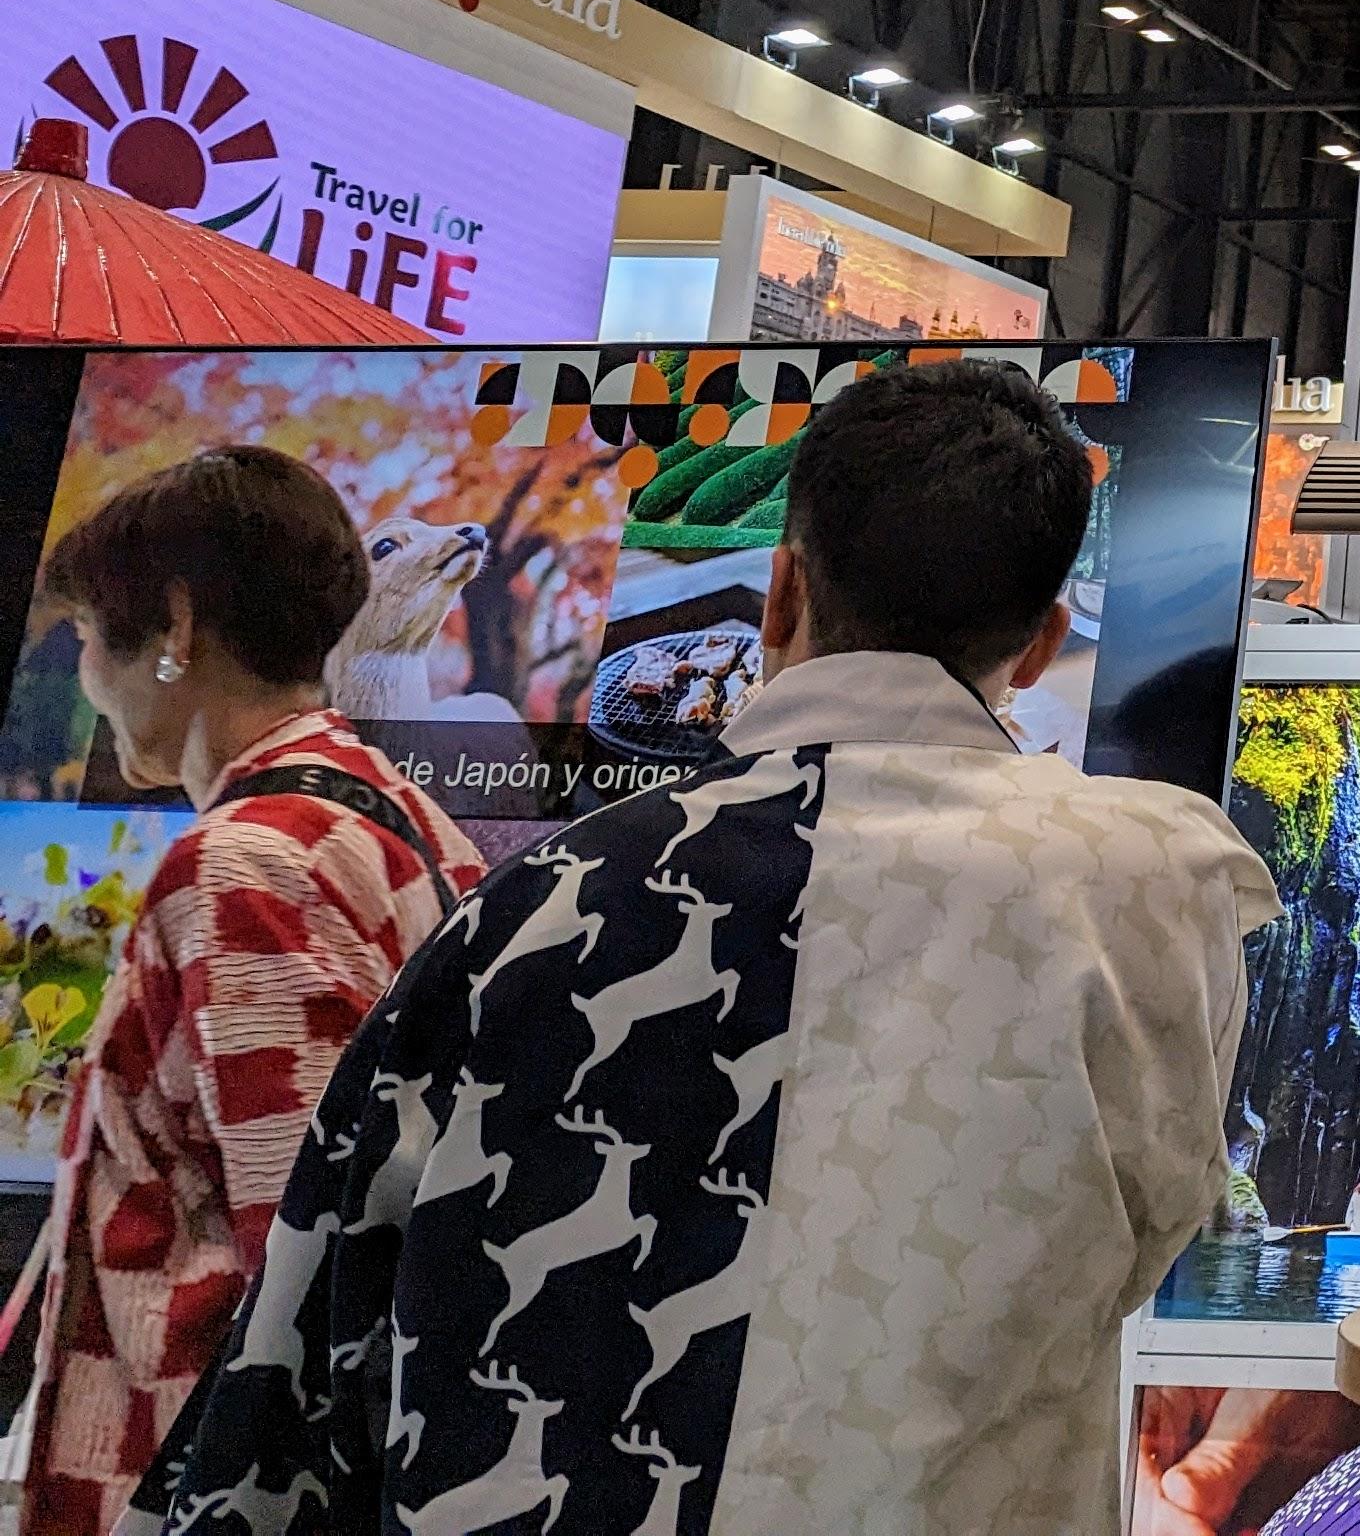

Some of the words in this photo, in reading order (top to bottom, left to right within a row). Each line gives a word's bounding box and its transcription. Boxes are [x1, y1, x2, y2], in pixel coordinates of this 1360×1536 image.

[310, 161, 421, 227] Travel
[432, 205, 484, 244] for
[395, 752, 434, 786] de
[445, 752, 551, 795] Japón
[560, 763, 585, 796] y
[593, 756, 694, 792] orige
